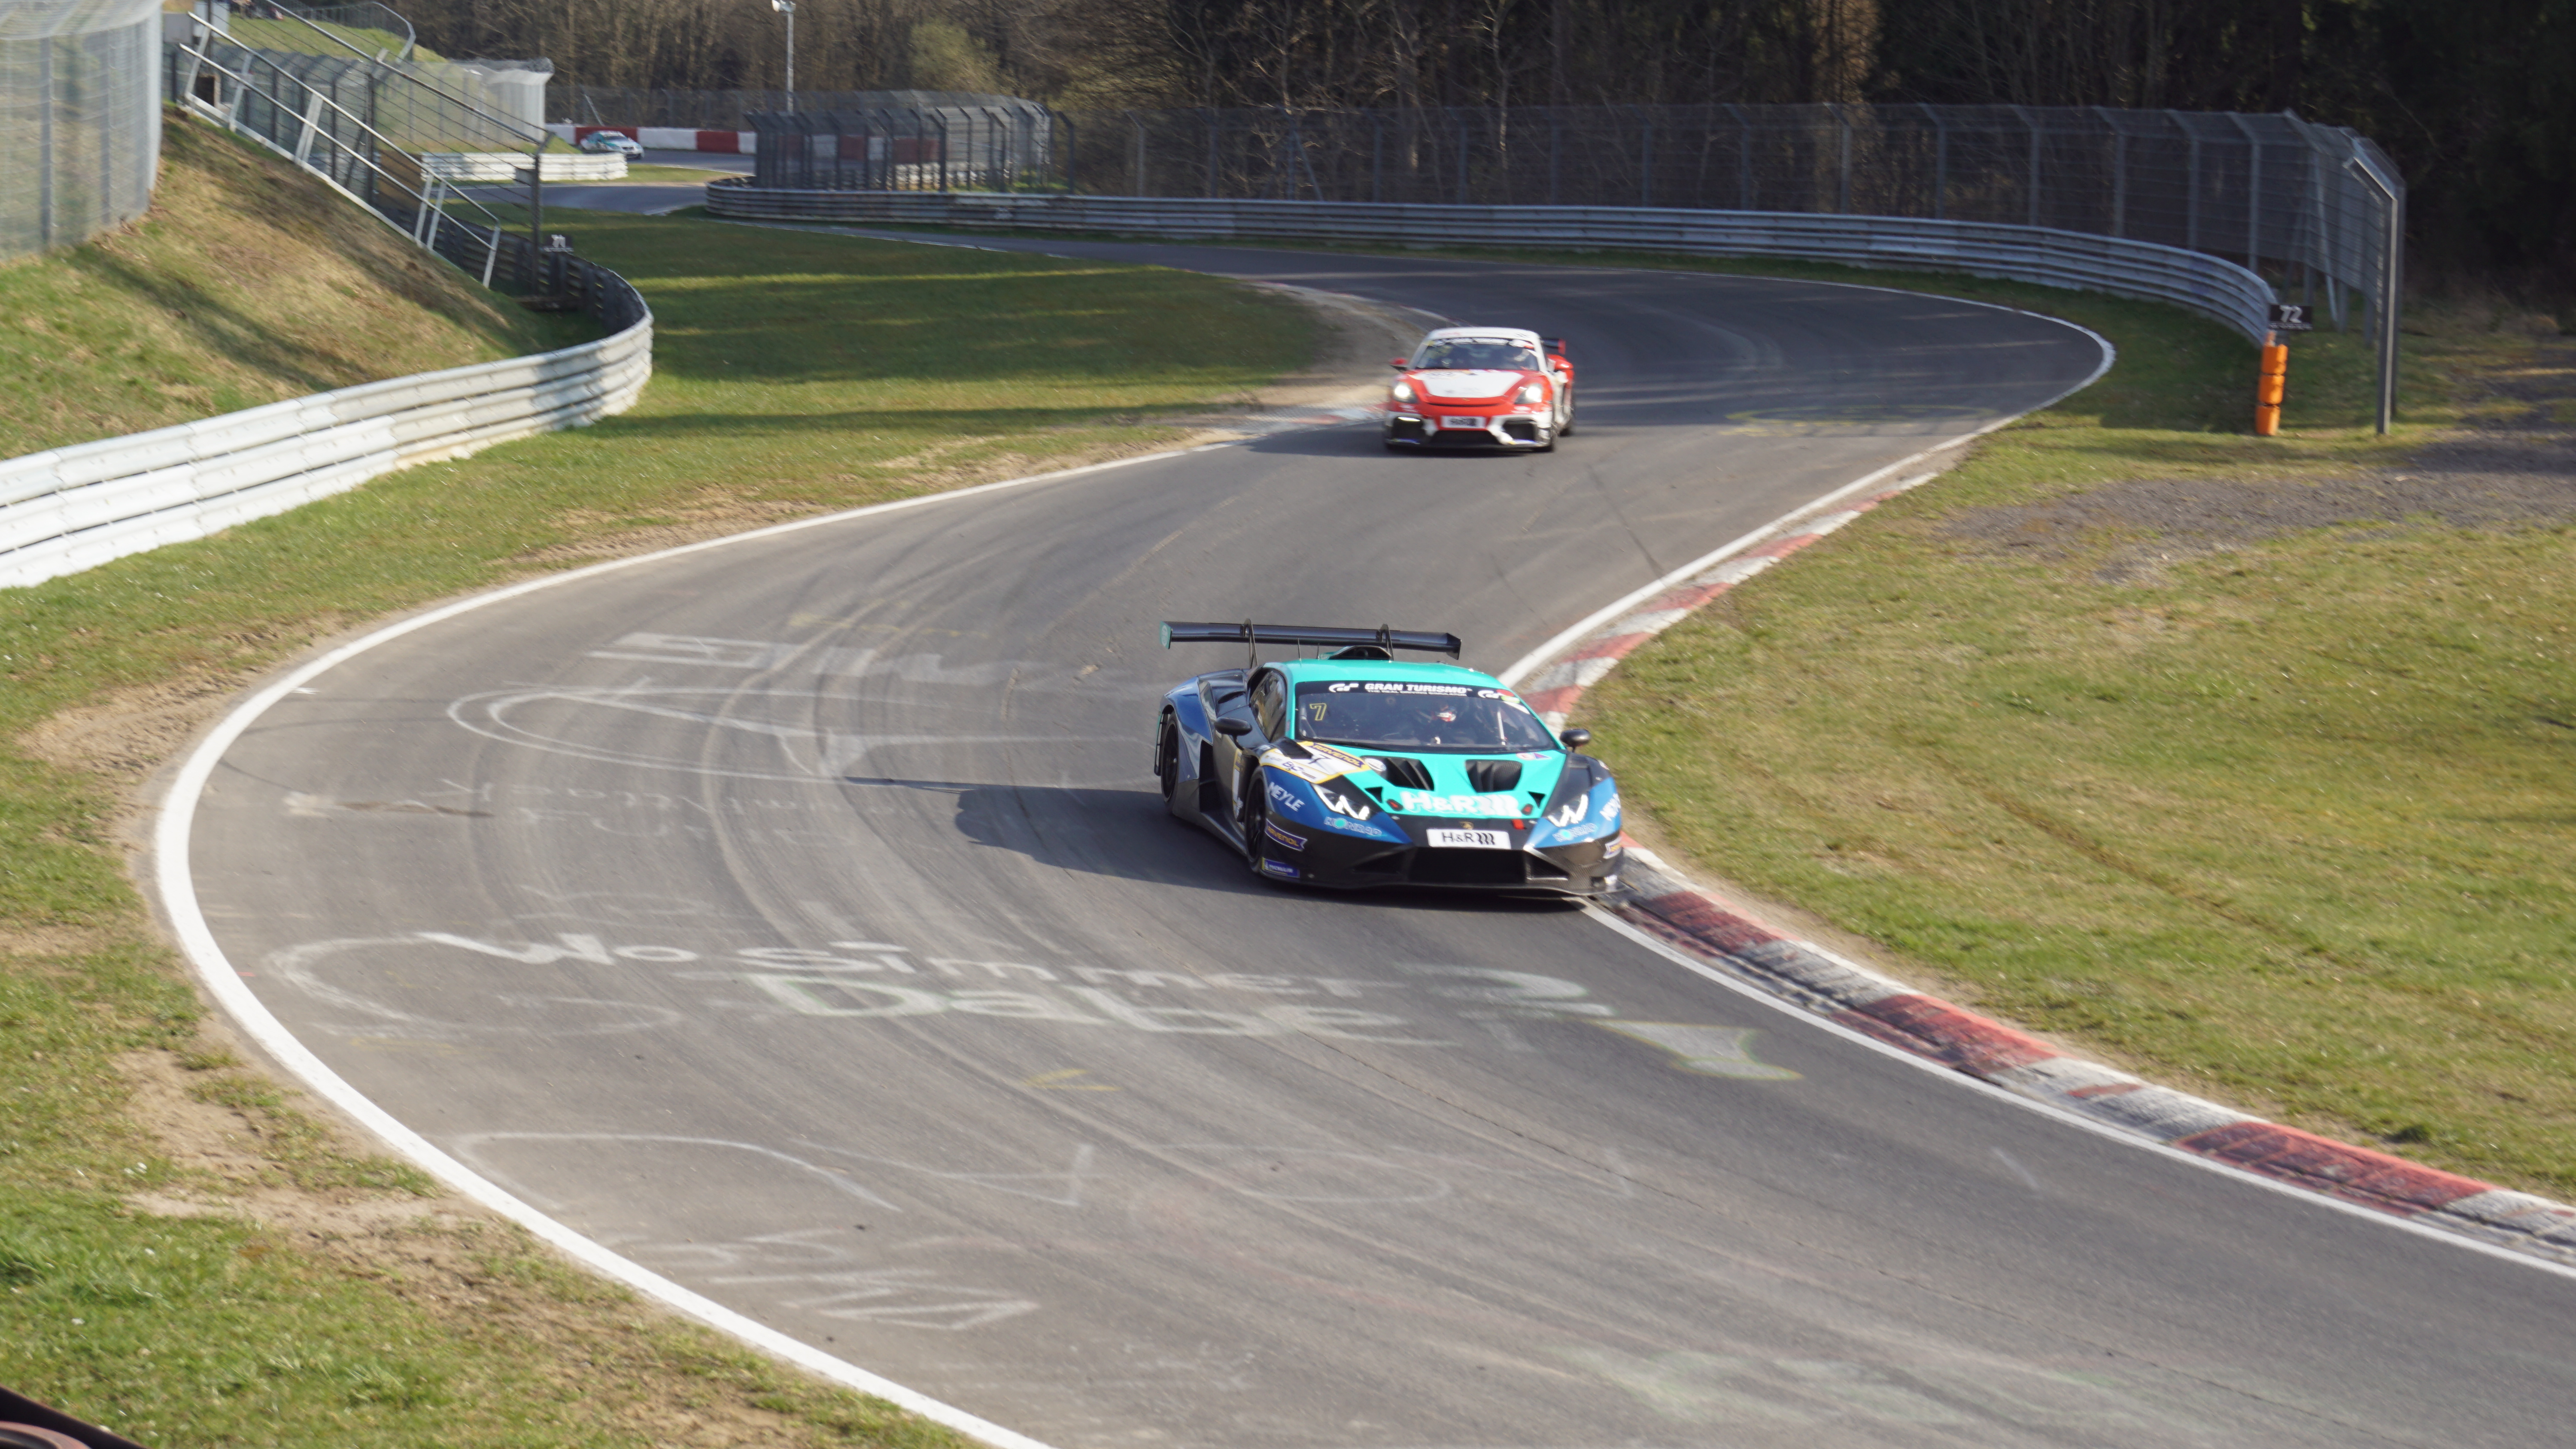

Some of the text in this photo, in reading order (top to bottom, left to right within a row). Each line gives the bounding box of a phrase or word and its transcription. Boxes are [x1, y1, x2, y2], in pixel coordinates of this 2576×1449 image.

[2280, 305, 2303, 323] 72
[1406, 685, 1467, 694] TURISMO
[1309, 703, 1327, 721] 7
[1313, 745, 1361, 766] RAVENOL
[1267, 782, 1305, 812] MEYLE
[1442, 832, 1476, 843] H&R
